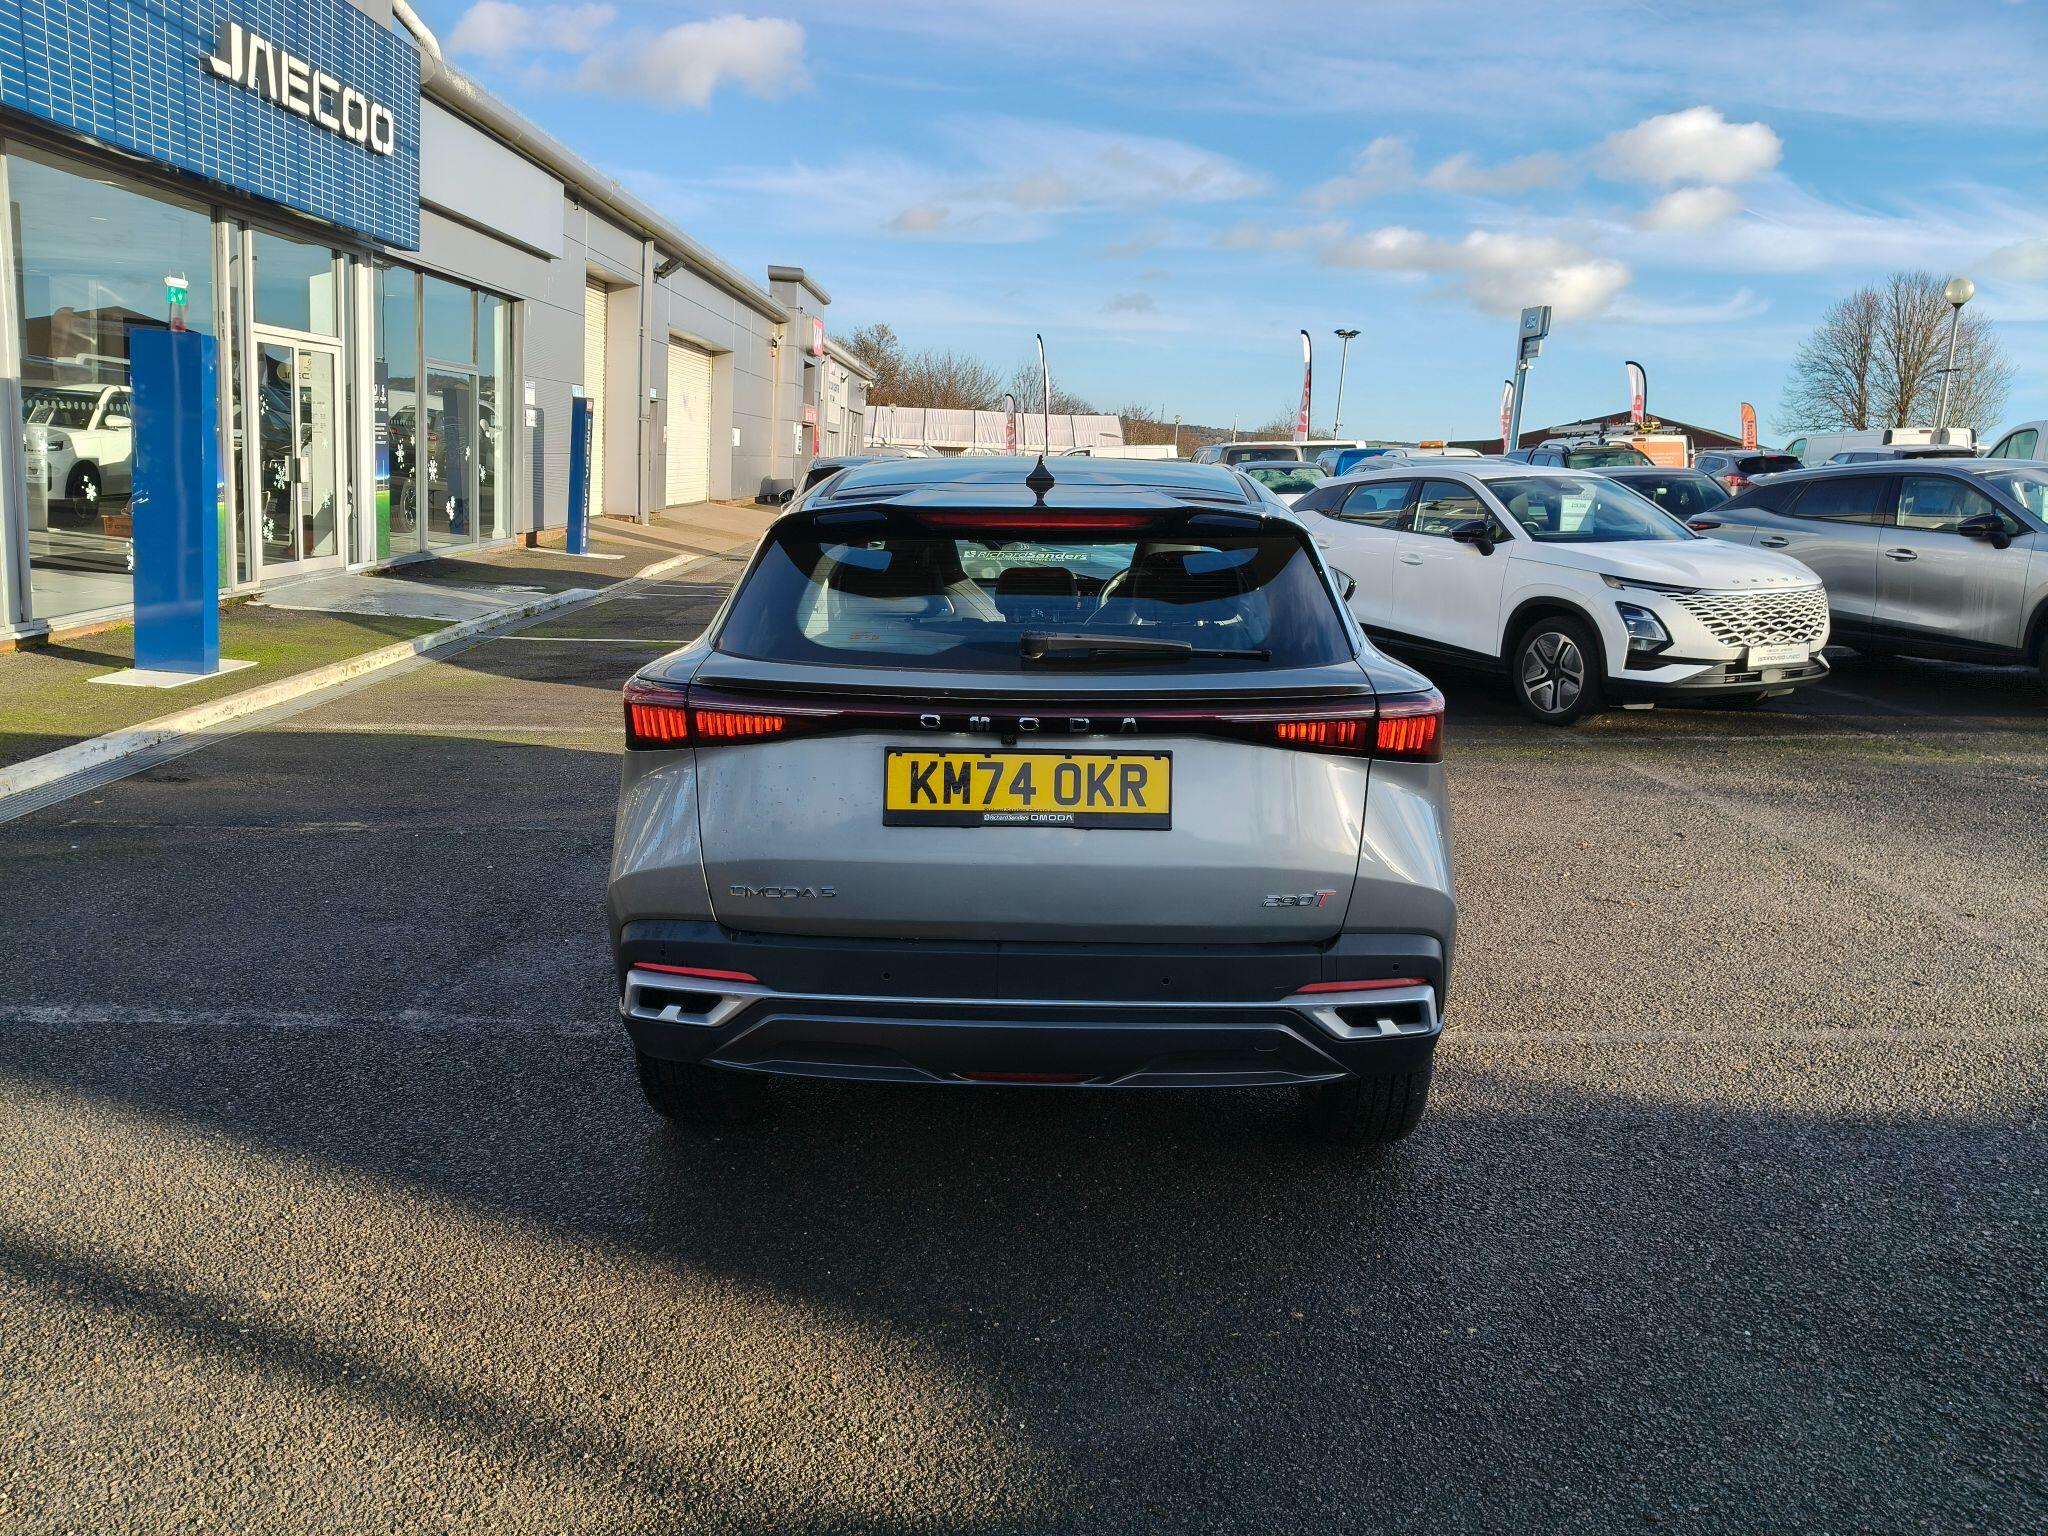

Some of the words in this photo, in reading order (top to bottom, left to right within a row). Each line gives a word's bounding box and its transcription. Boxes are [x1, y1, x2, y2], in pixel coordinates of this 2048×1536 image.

[206, 21, 393, 156] JAECOO
[920, 714, 1139, 733] OMODA
[910, 761, 1036, 804] KM74
[1053, 762, 1148, 807] OKR
[729, 885, 817, 898] OMODA
[821, 887, 837, 898] 5
[1262, 889, 1337, 908] 290T
